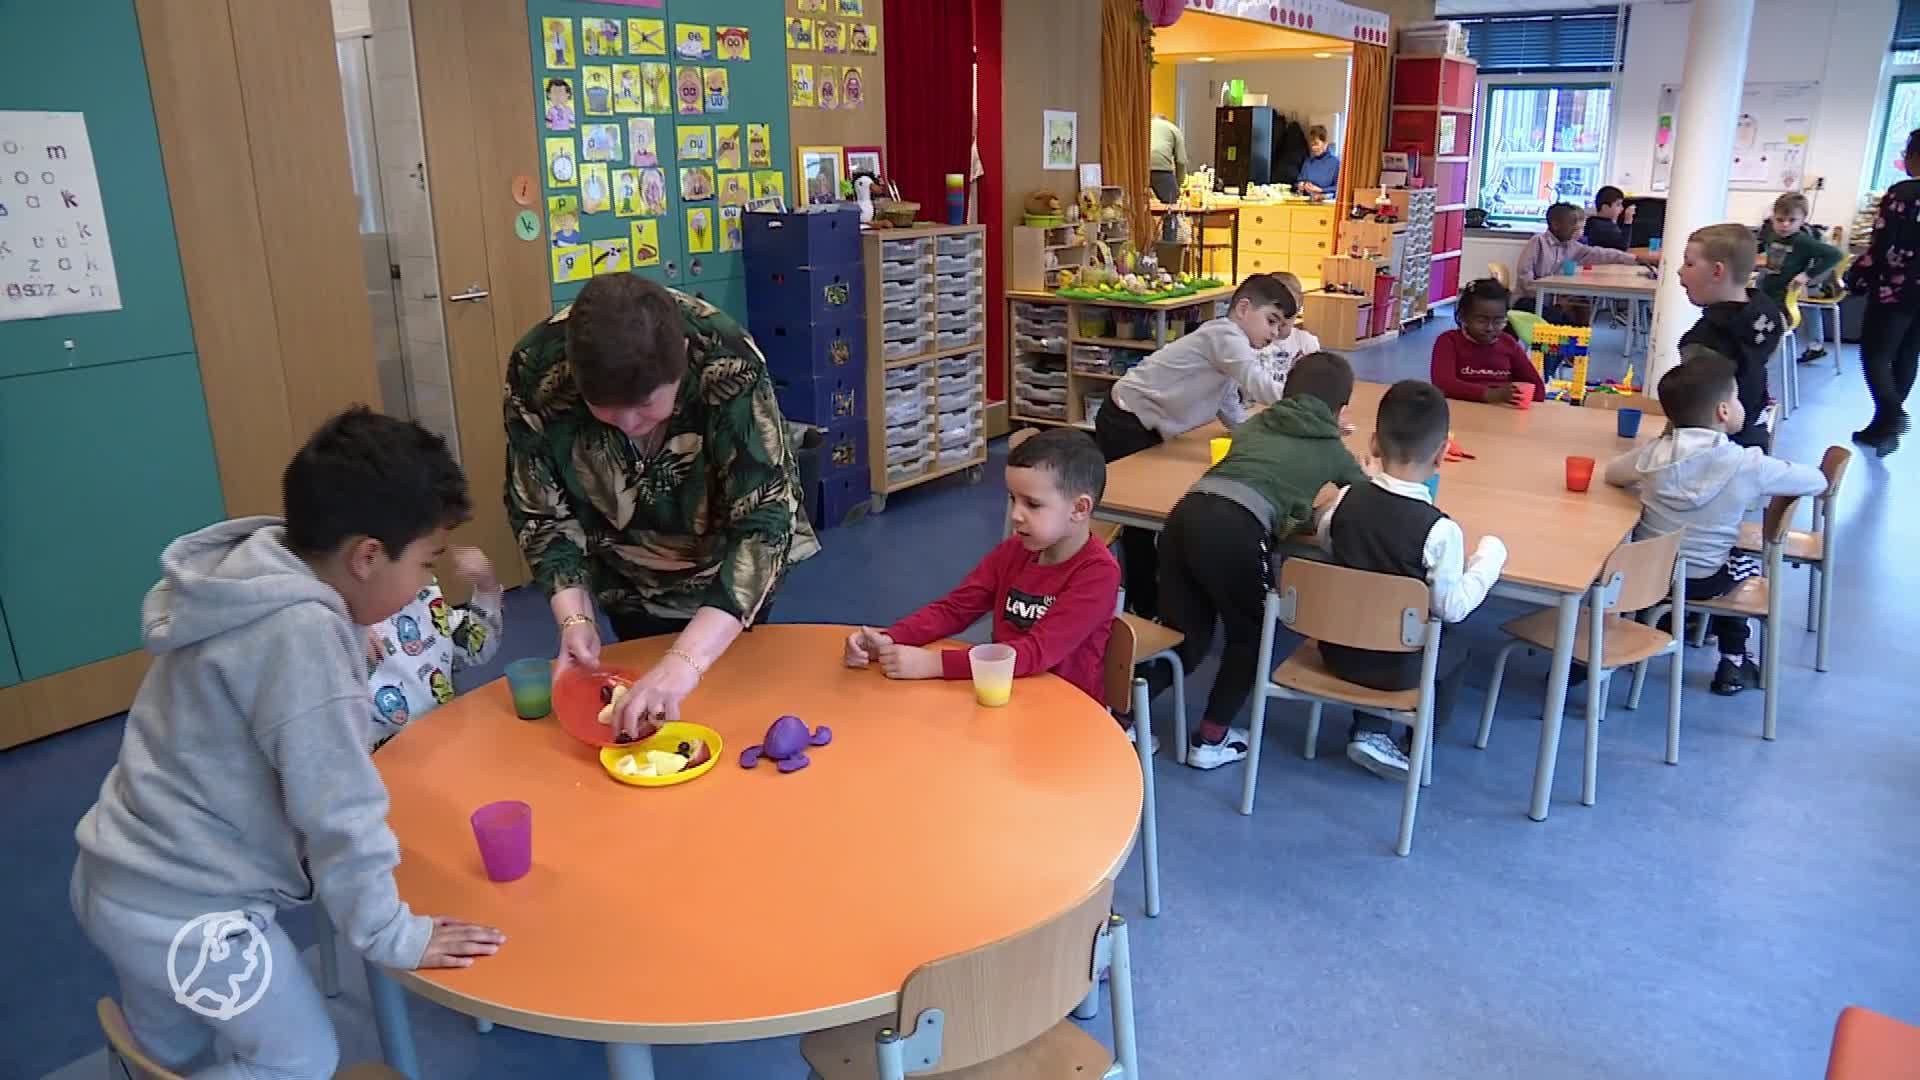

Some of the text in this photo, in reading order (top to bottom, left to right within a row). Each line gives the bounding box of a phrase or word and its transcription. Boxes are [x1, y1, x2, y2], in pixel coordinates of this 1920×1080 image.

[46, 144, 67, 160] m
[60, 189, 79, 208] k
[521, 216, 534, 232] k
